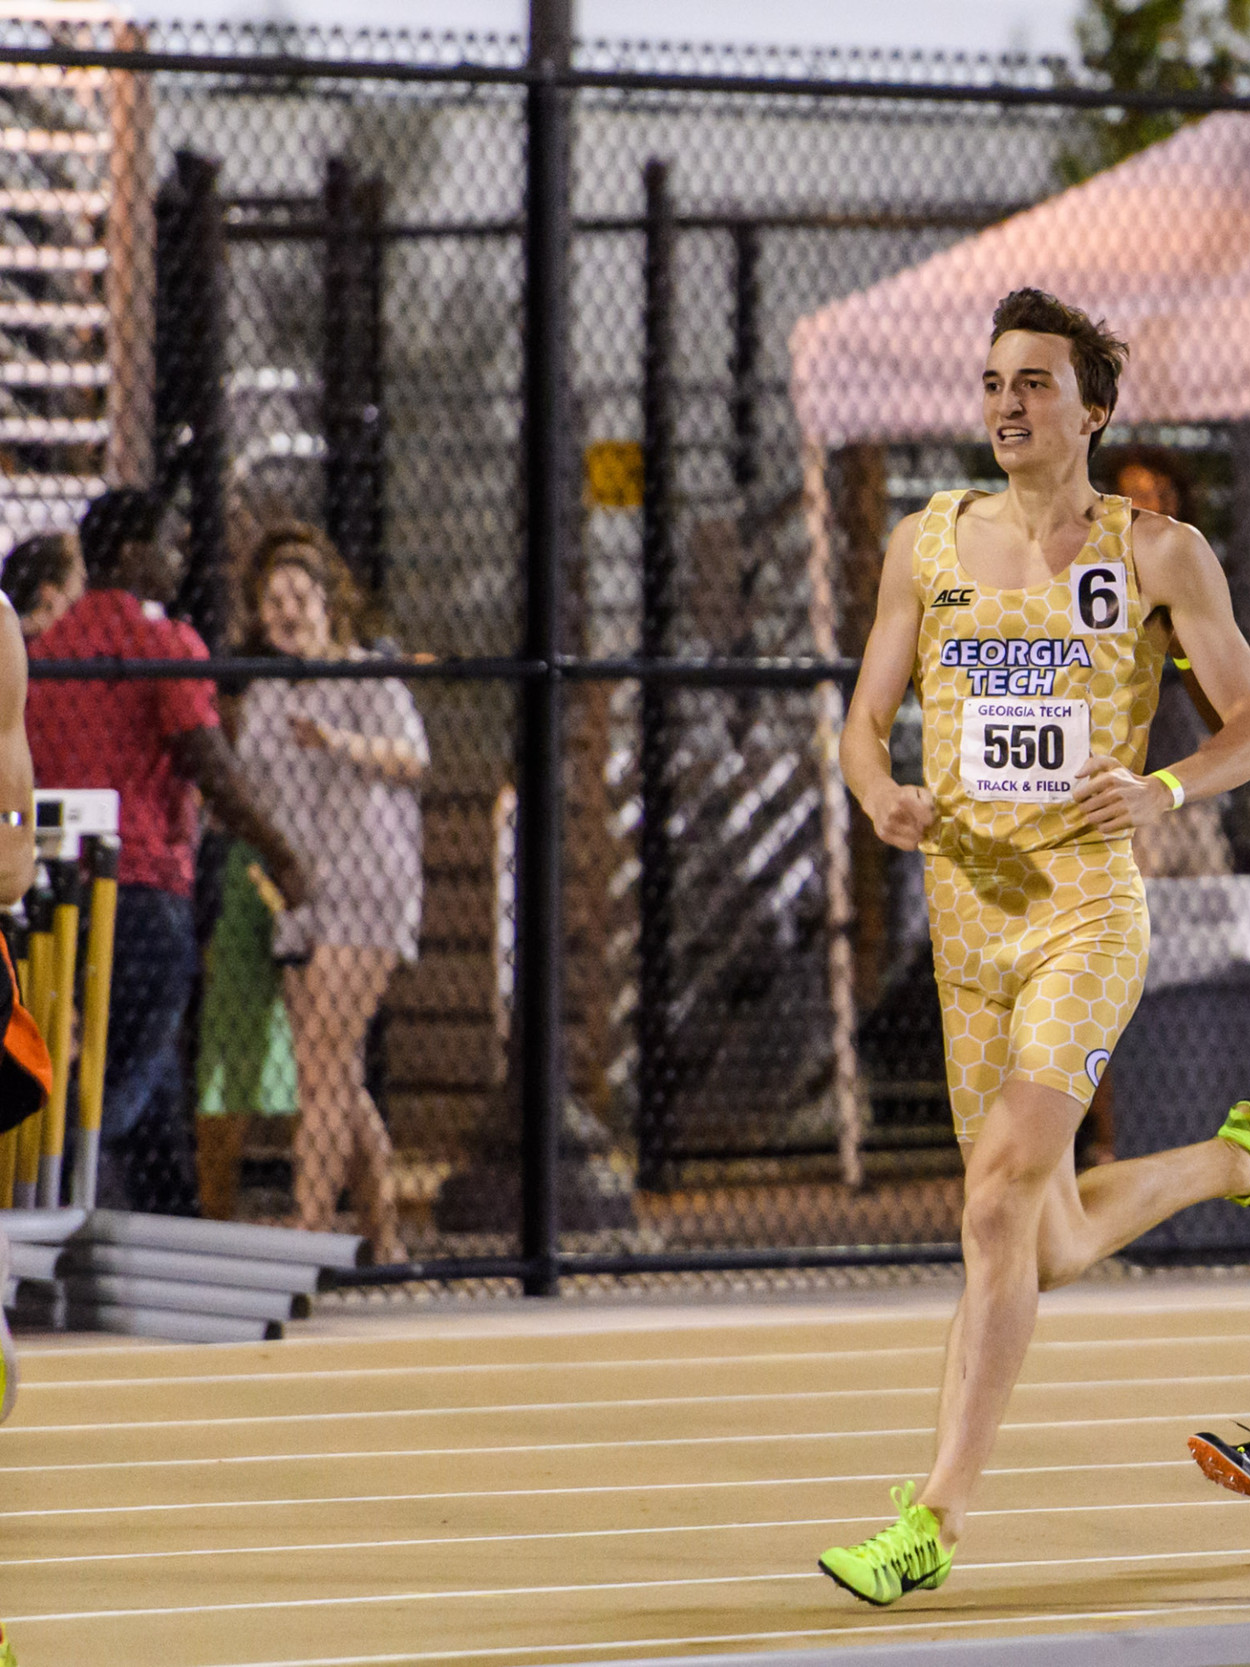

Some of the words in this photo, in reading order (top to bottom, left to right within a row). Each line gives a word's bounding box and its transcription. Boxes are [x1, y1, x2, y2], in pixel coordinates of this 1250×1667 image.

[932, 588, 975, 605] ACC
[1078, 568, 1119, 630] 6
[940, 638, 1092, 668] GEORGIA
[967, 668, 1056, 696] TECH
[978, 705, 1035, 717] GEORGIA
[1040, 706, 1072, 717] TECH
[983, 724, 1064, 770] 550
[977, 780, 1017, 792] TRACK
[1022, 781, 1031, 792] &
[1036, 780, 1071, 792] FIELD
